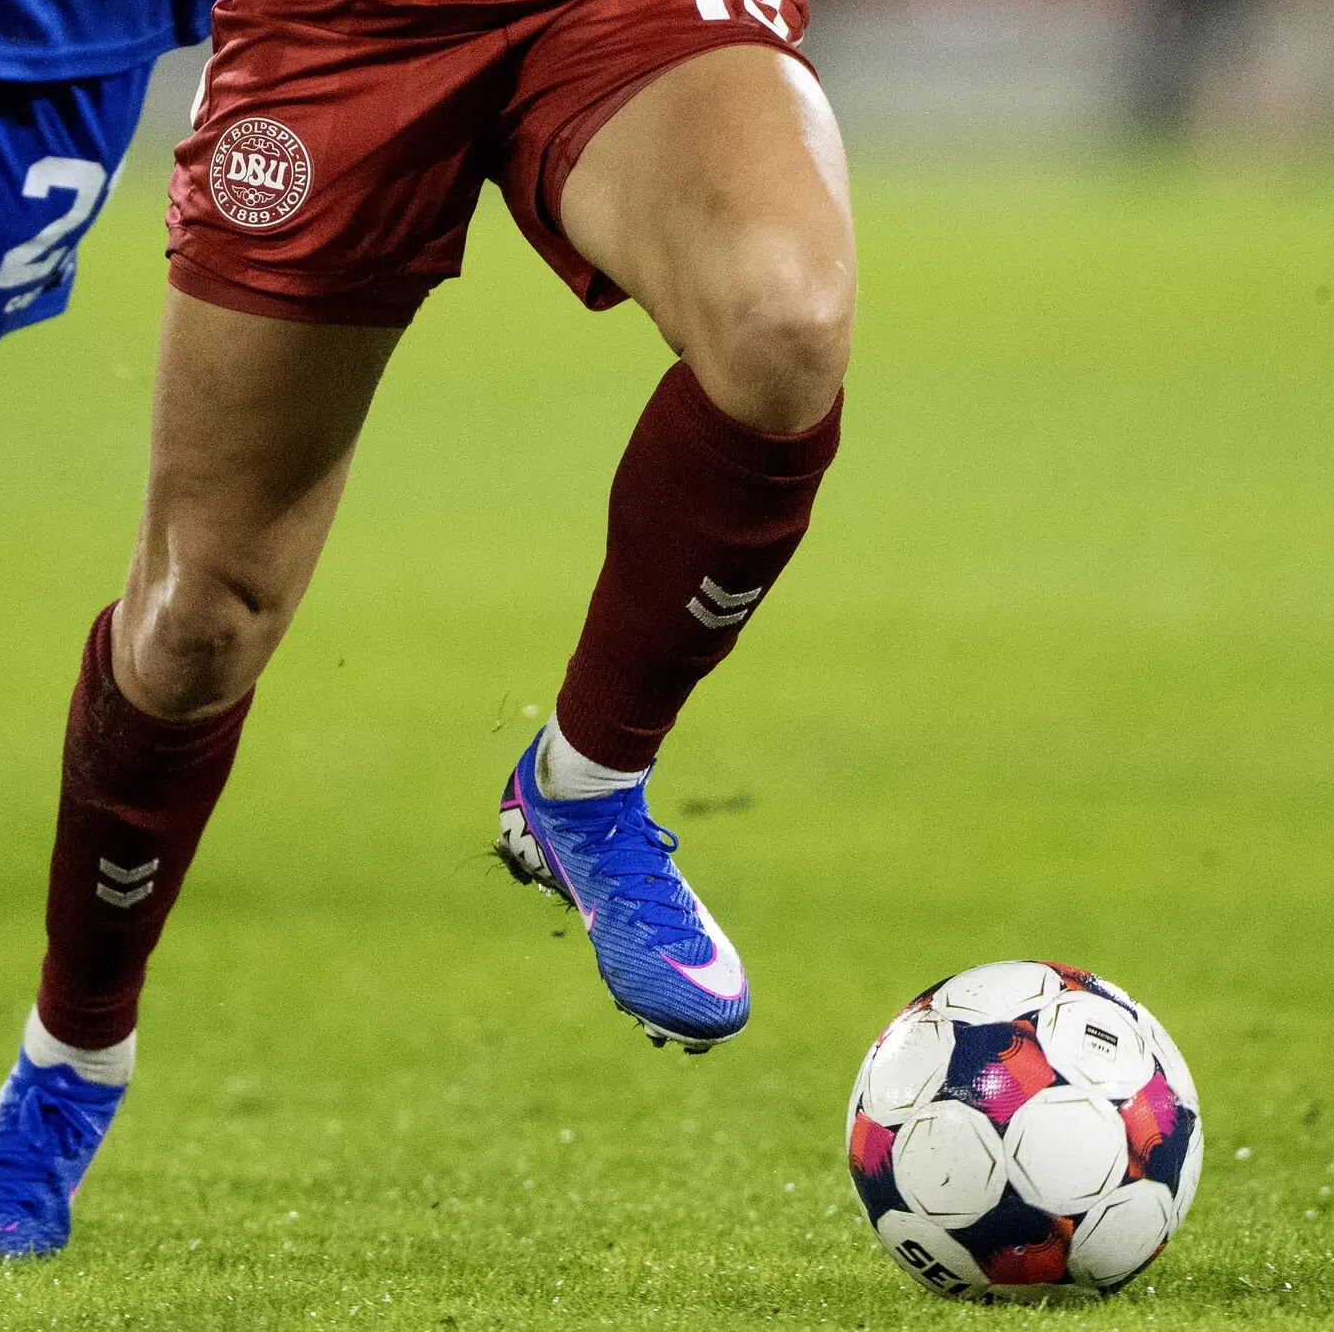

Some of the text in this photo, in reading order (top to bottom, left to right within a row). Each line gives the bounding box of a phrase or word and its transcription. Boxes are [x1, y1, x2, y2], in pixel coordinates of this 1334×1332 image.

[213, 139, 231, 205] DANSK
[229, 205, 271, 223] 1889
[227, 151, 288, 190] DBU
